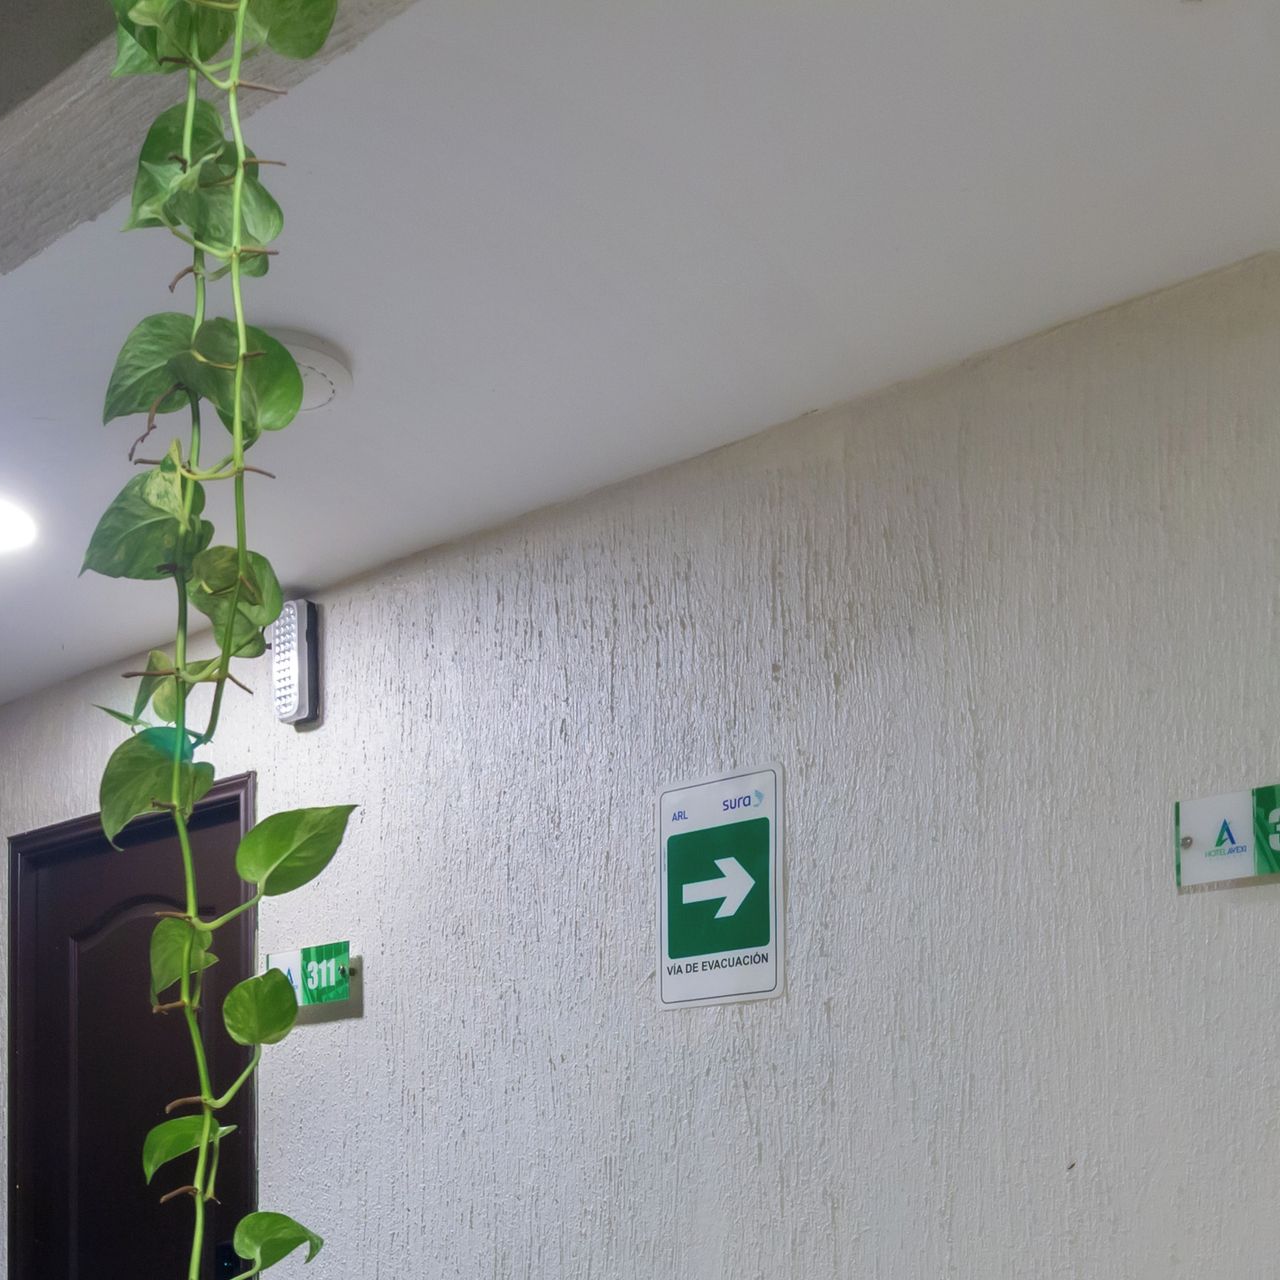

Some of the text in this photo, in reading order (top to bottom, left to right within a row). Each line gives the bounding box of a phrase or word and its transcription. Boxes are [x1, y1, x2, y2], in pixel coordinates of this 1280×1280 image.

[722, 795, 751, 812] sura
[672, 810, 688, 822] ARL
[307, 958, 336, 990] 311
[666, 951, 769, 976] VÍA DE EVACUACIÓN
